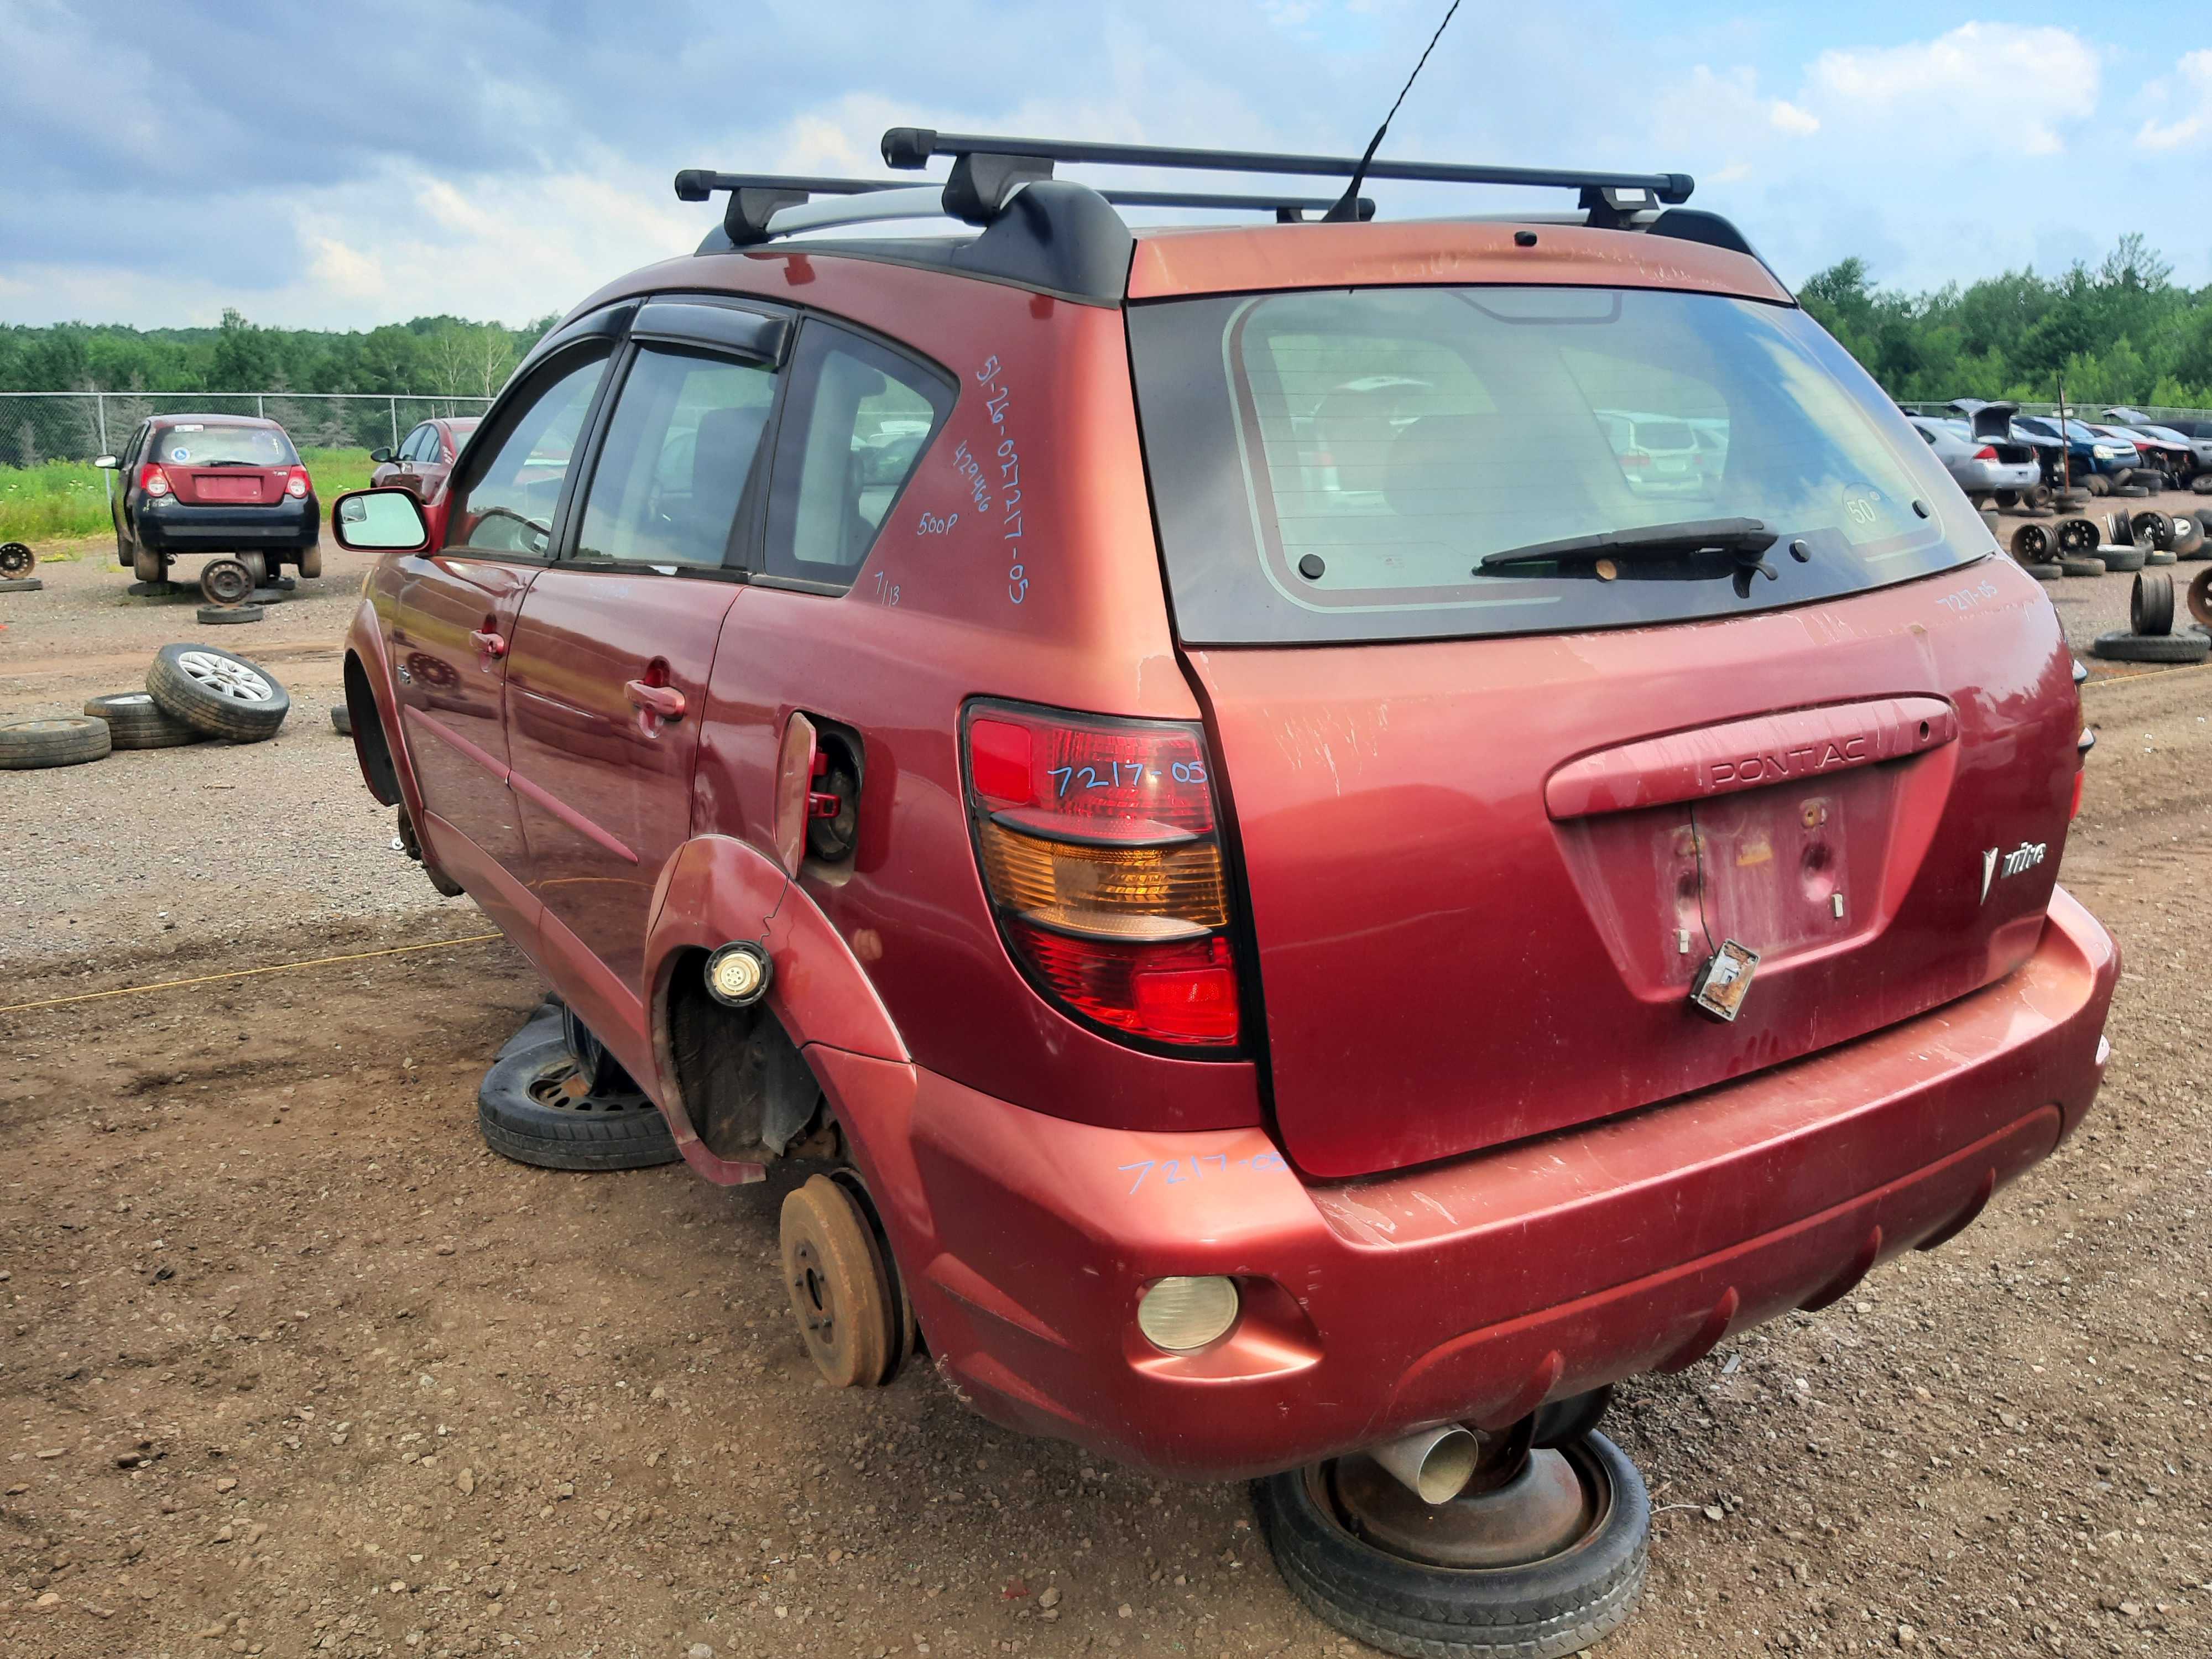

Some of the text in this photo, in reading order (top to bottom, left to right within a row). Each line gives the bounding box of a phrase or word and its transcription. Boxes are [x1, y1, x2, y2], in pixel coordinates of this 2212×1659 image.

[1047, 761, 1208, 796] 7217-05
[1711, 737, 1866, 788] PONTIAC
[1117, 1151, 1290, 1195] 7217-05
